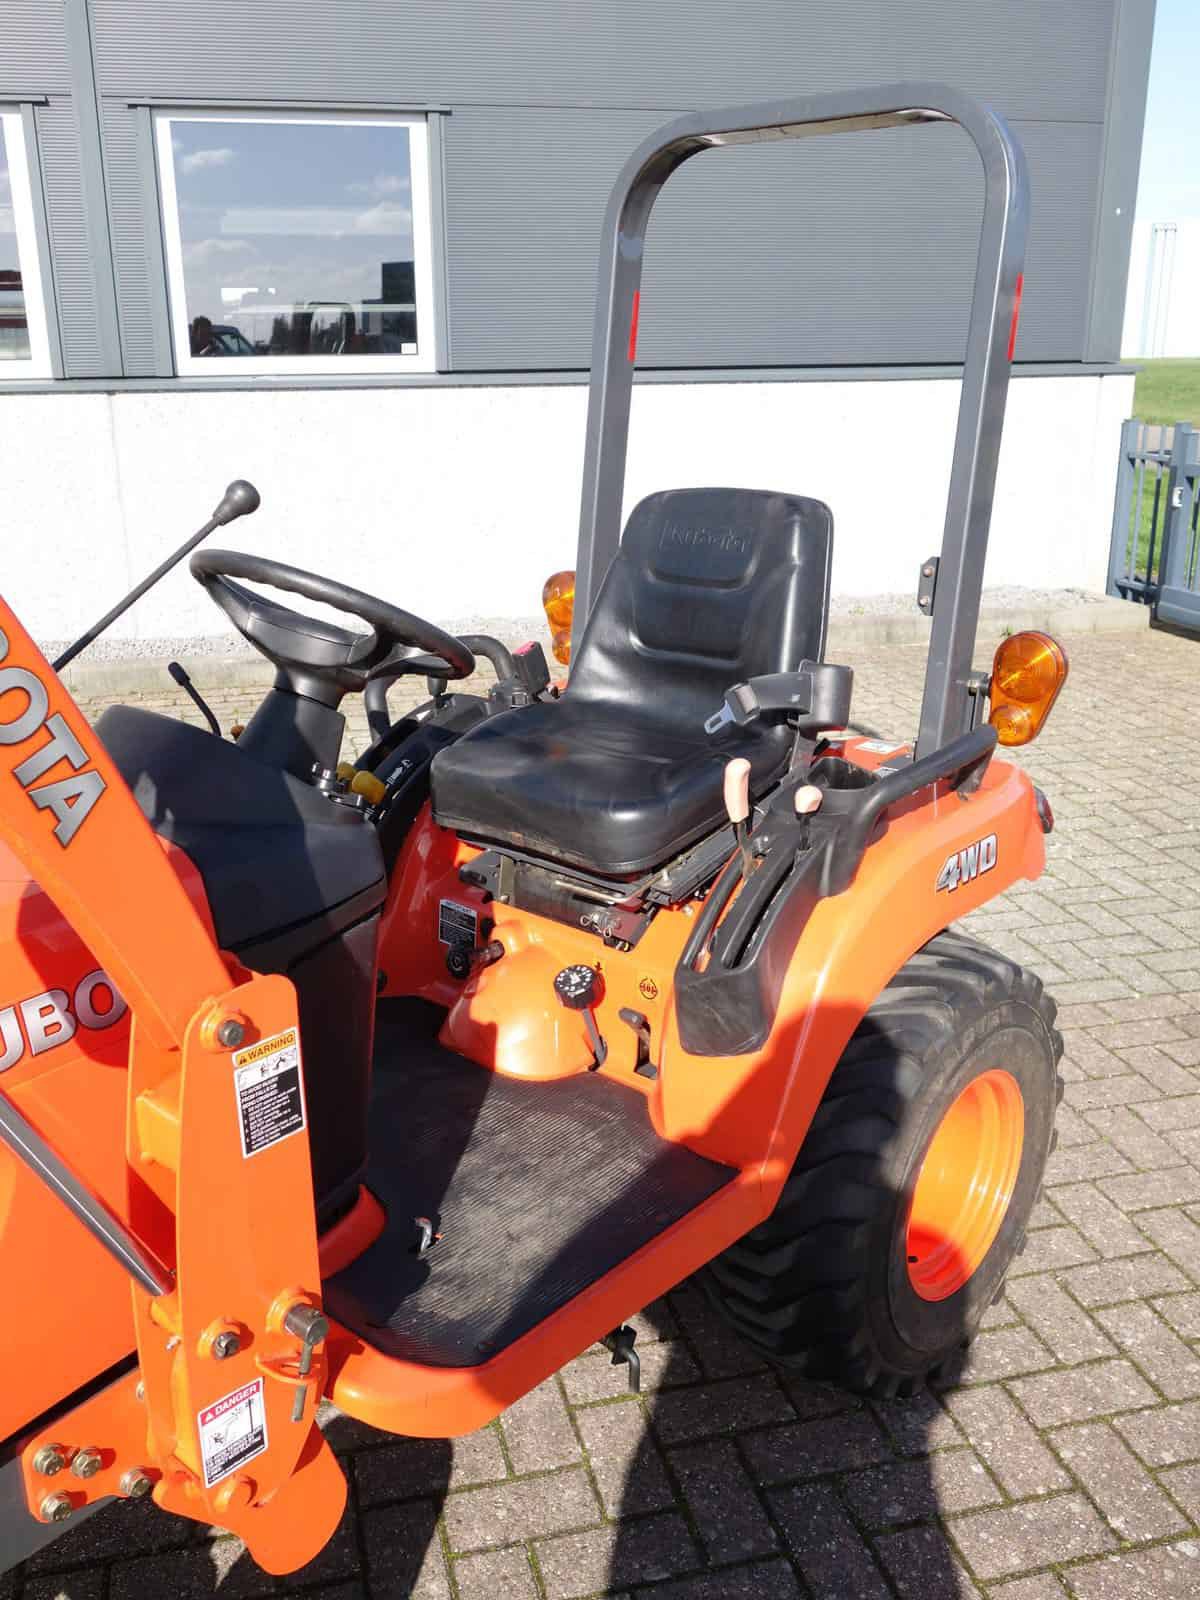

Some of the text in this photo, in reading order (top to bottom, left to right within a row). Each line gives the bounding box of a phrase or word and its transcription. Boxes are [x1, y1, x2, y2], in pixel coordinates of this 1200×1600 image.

[0, 626, 108, 849] OTA
[936, 832, 998, 893] 4WD
[248, 1033, 294, 1060] WARNING
[215, 1384, 257, 1414] DANGER
